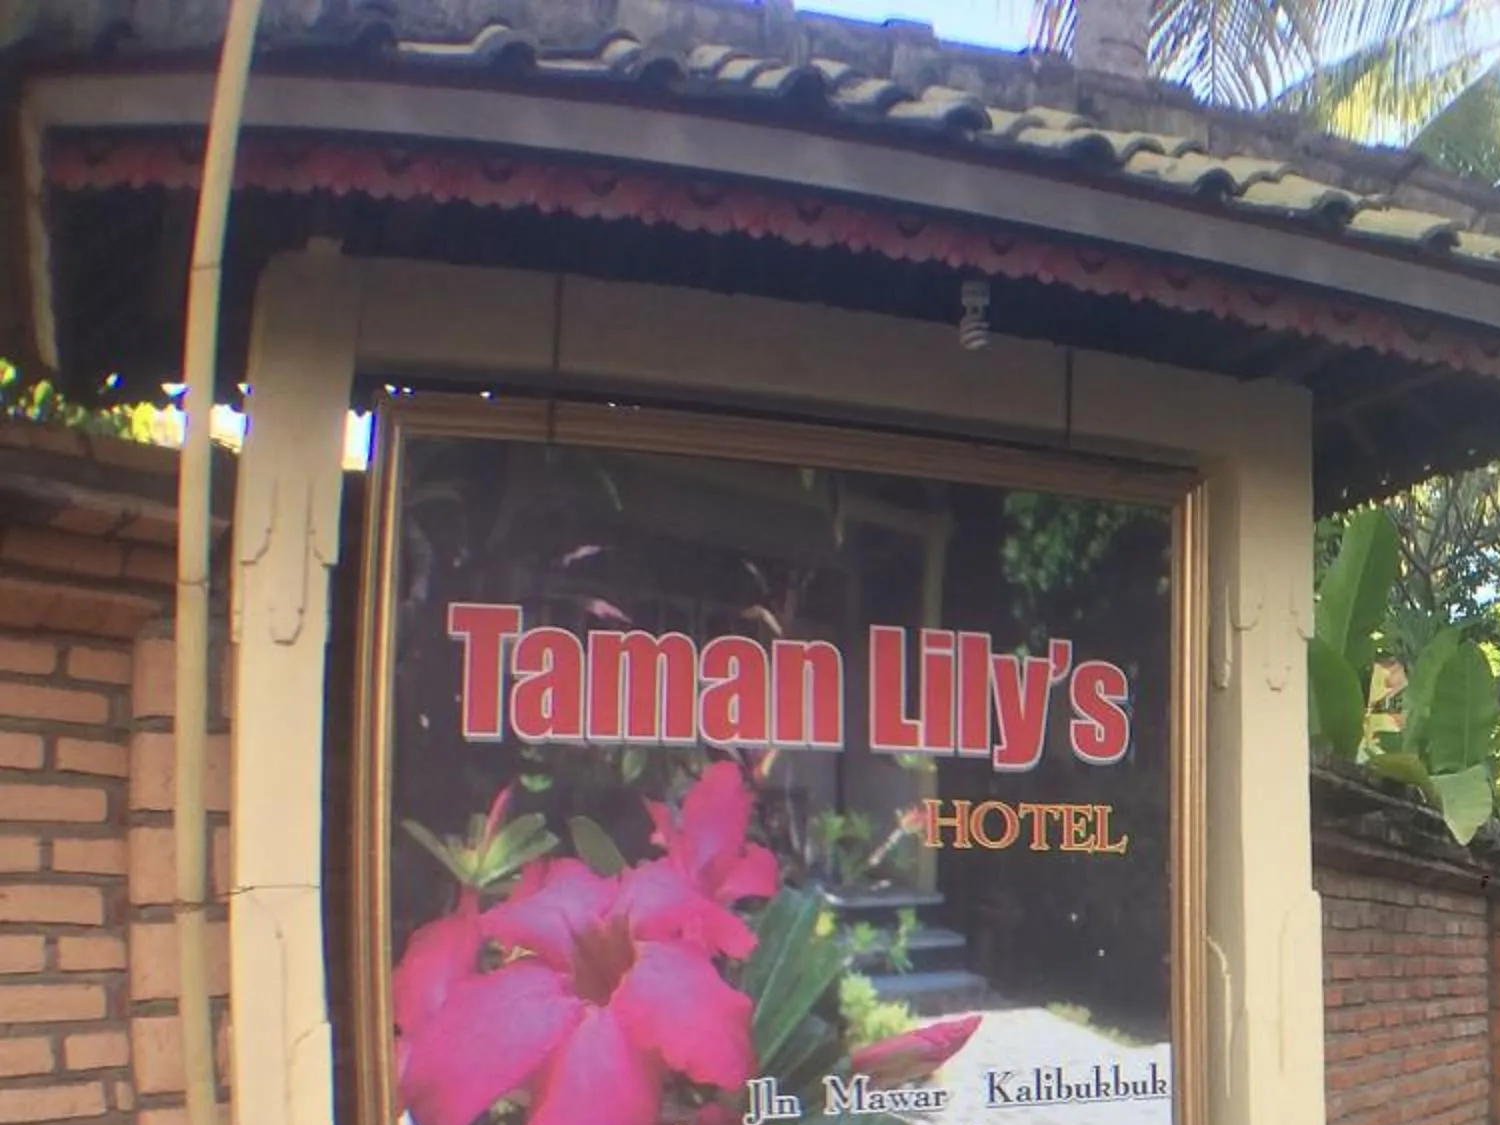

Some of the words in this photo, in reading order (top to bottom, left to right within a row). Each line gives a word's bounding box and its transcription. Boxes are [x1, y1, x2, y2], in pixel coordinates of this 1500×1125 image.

[447, 603, 845, 750] Taman
[869, 625, 1134, 771] Lily's
[924, 800, 1128, 855] HOTEL
[824, 1075, 947, 1115] Mawar
[986, 1063, 1170, 1107] Kalibukbuk
